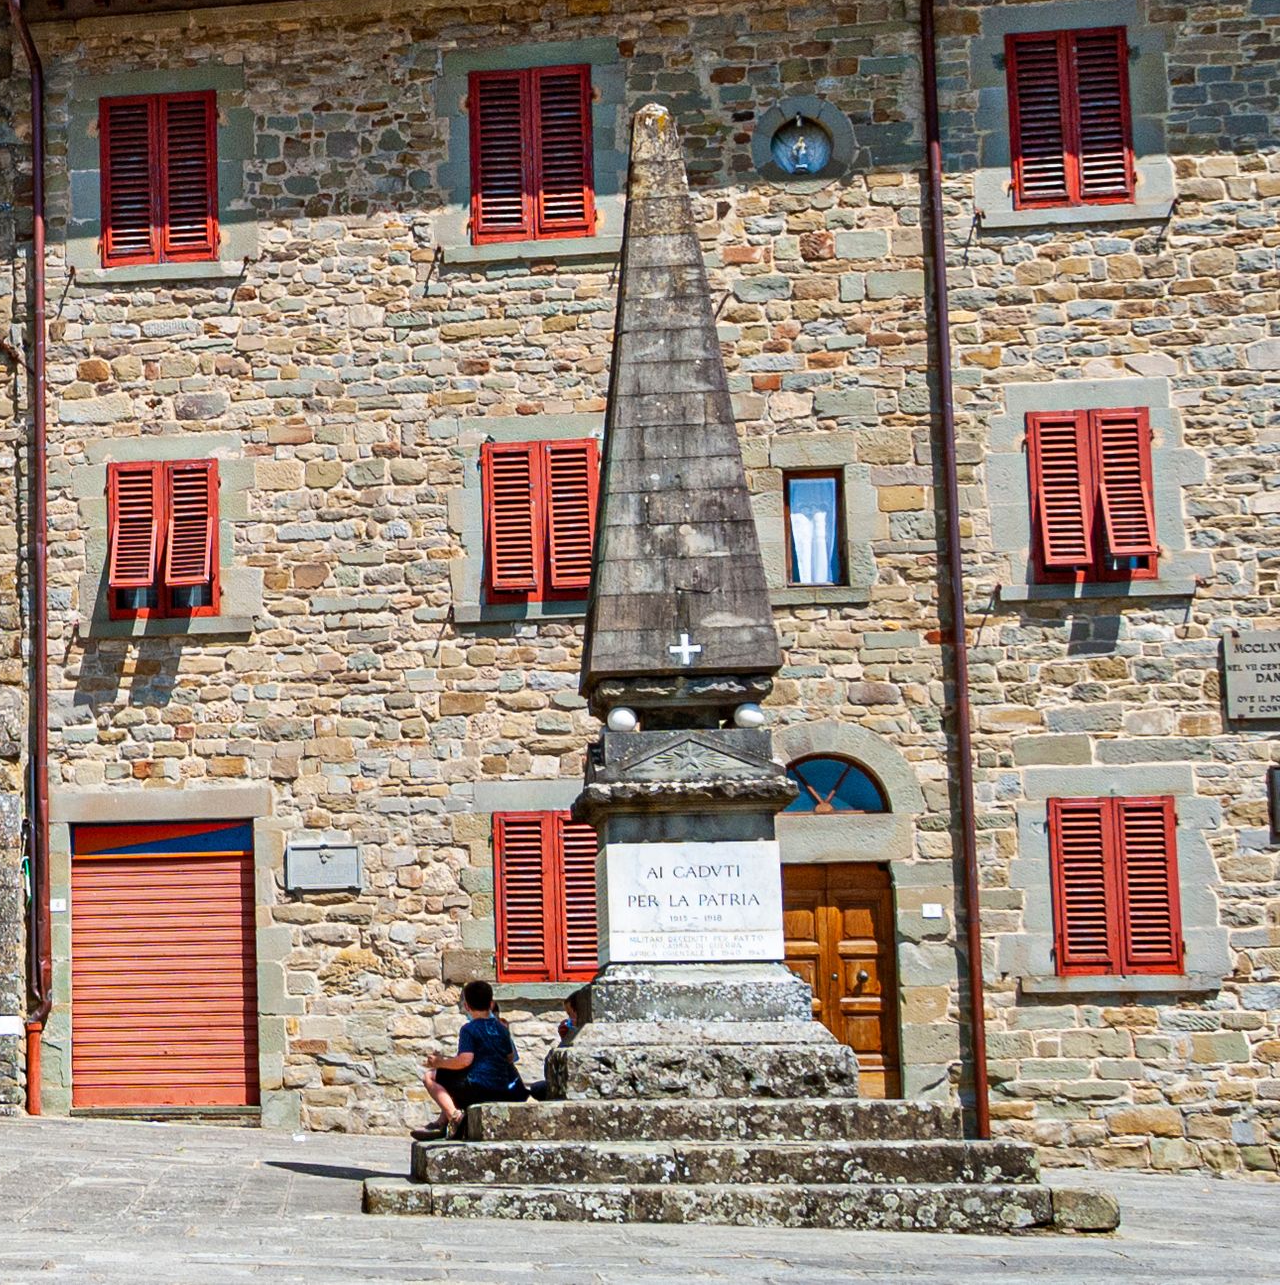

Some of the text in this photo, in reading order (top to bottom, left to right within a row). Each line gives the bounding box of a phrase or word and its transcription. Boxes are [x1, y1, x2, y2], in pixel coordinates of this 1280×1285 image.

[647, 864, 740, 879] AI CADVTI
[628, 893, 760, 908] PER LA PATRIA
